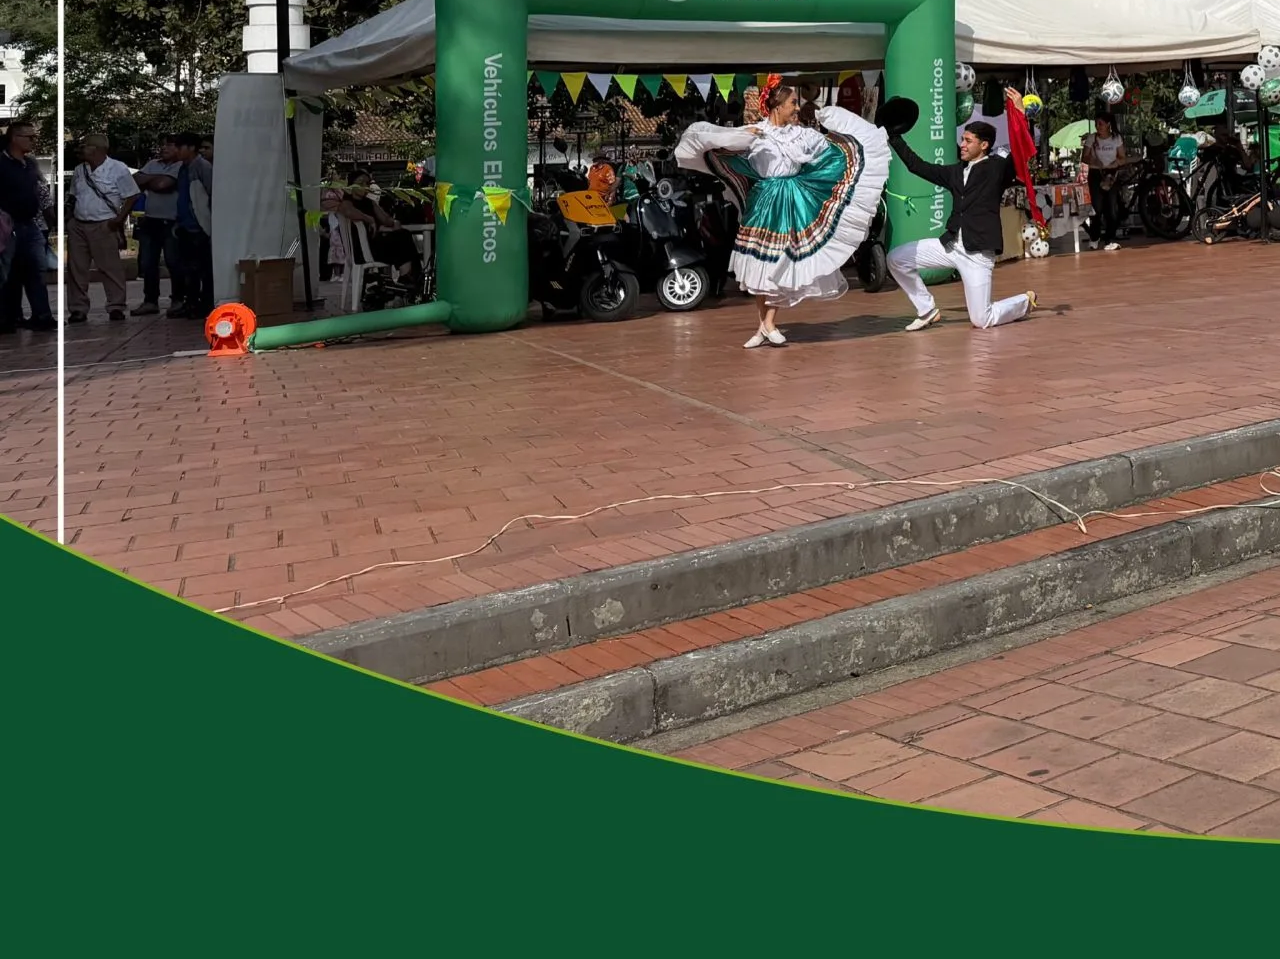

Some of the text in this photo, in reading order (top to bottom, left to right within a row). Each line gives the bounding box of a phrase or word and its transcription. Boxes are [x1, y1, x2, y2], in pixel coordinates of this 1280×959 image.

[483, 53, 502, 151] Vehículos
[930, 58, 944, 231] Vehícos Eléctricos
